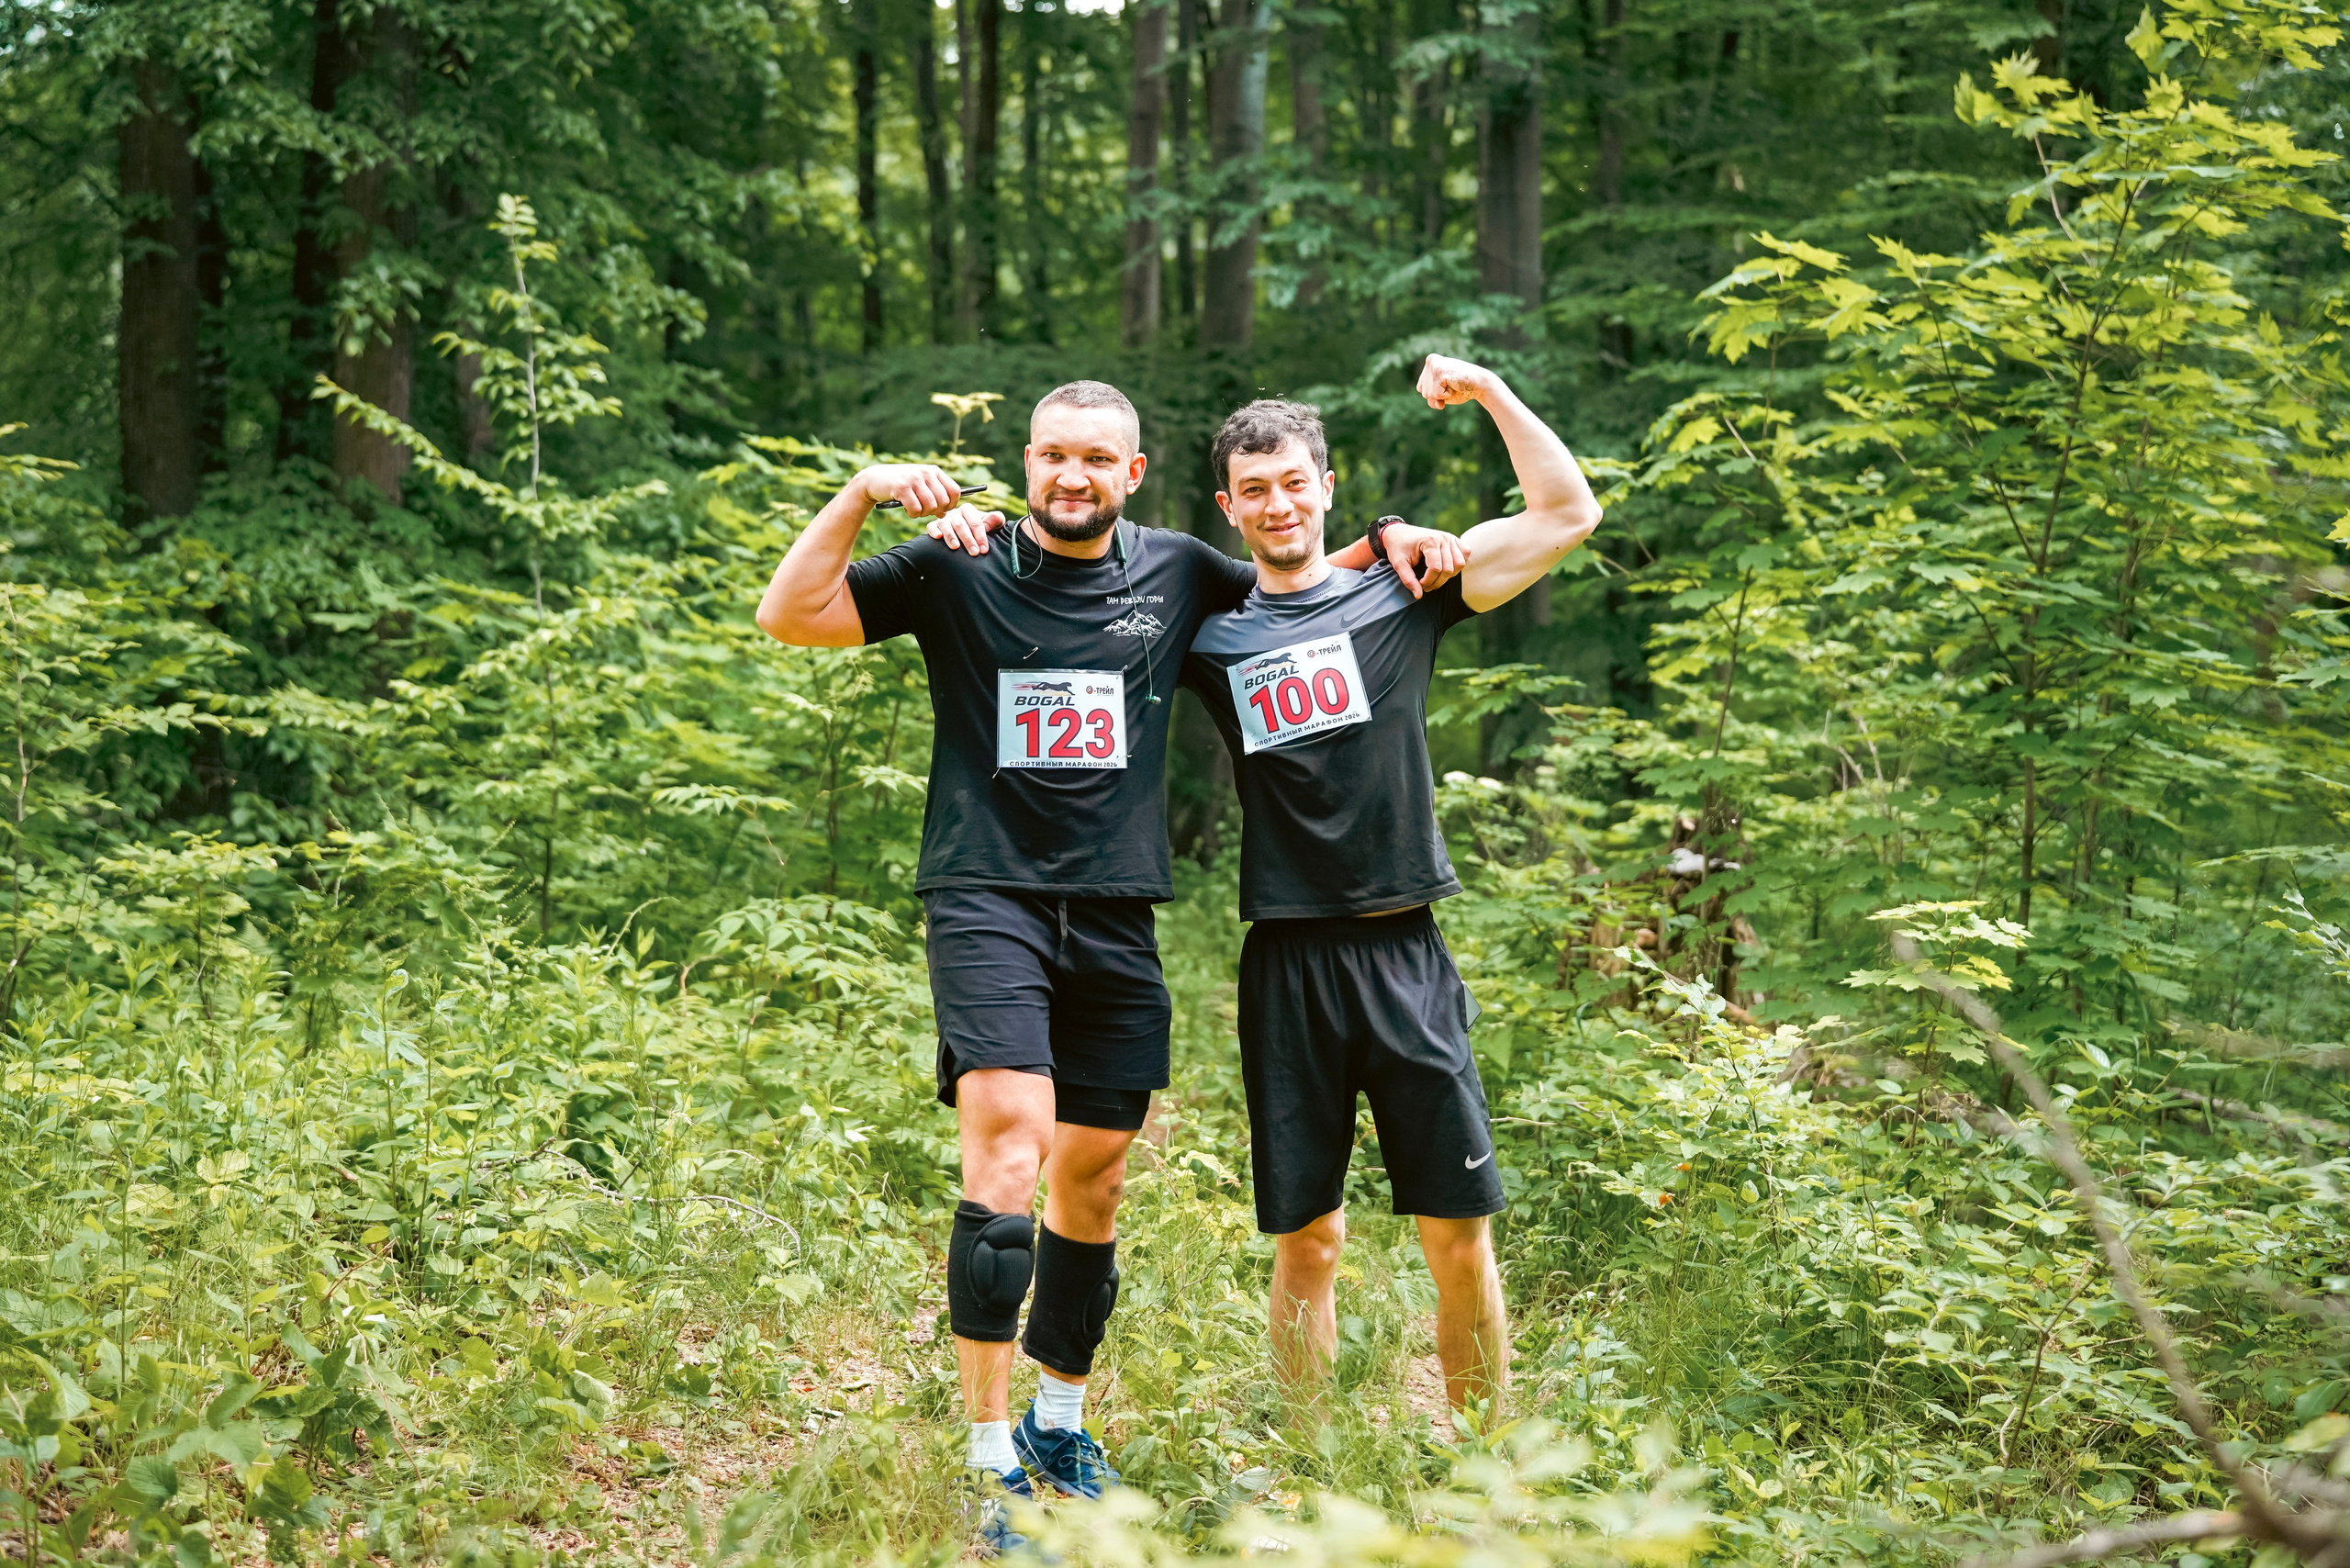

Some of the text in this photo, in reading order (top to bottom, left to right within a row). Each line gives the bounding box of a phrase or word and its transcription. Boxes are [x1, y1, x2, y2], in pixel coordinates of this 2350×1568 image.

[1106, 596, 1119, 605] ТАМ
[1147, 595, 1164, 604] ГОРЫ
[1244, 665, 1300, 690] BOGAL
[1013, 696, 1076, 706] BOGAL
[1248, 667, 1350, 734] 100
[1015, 708, 1115, 759] 123
[1304, 716, 1344, 732] МАРАФОН
